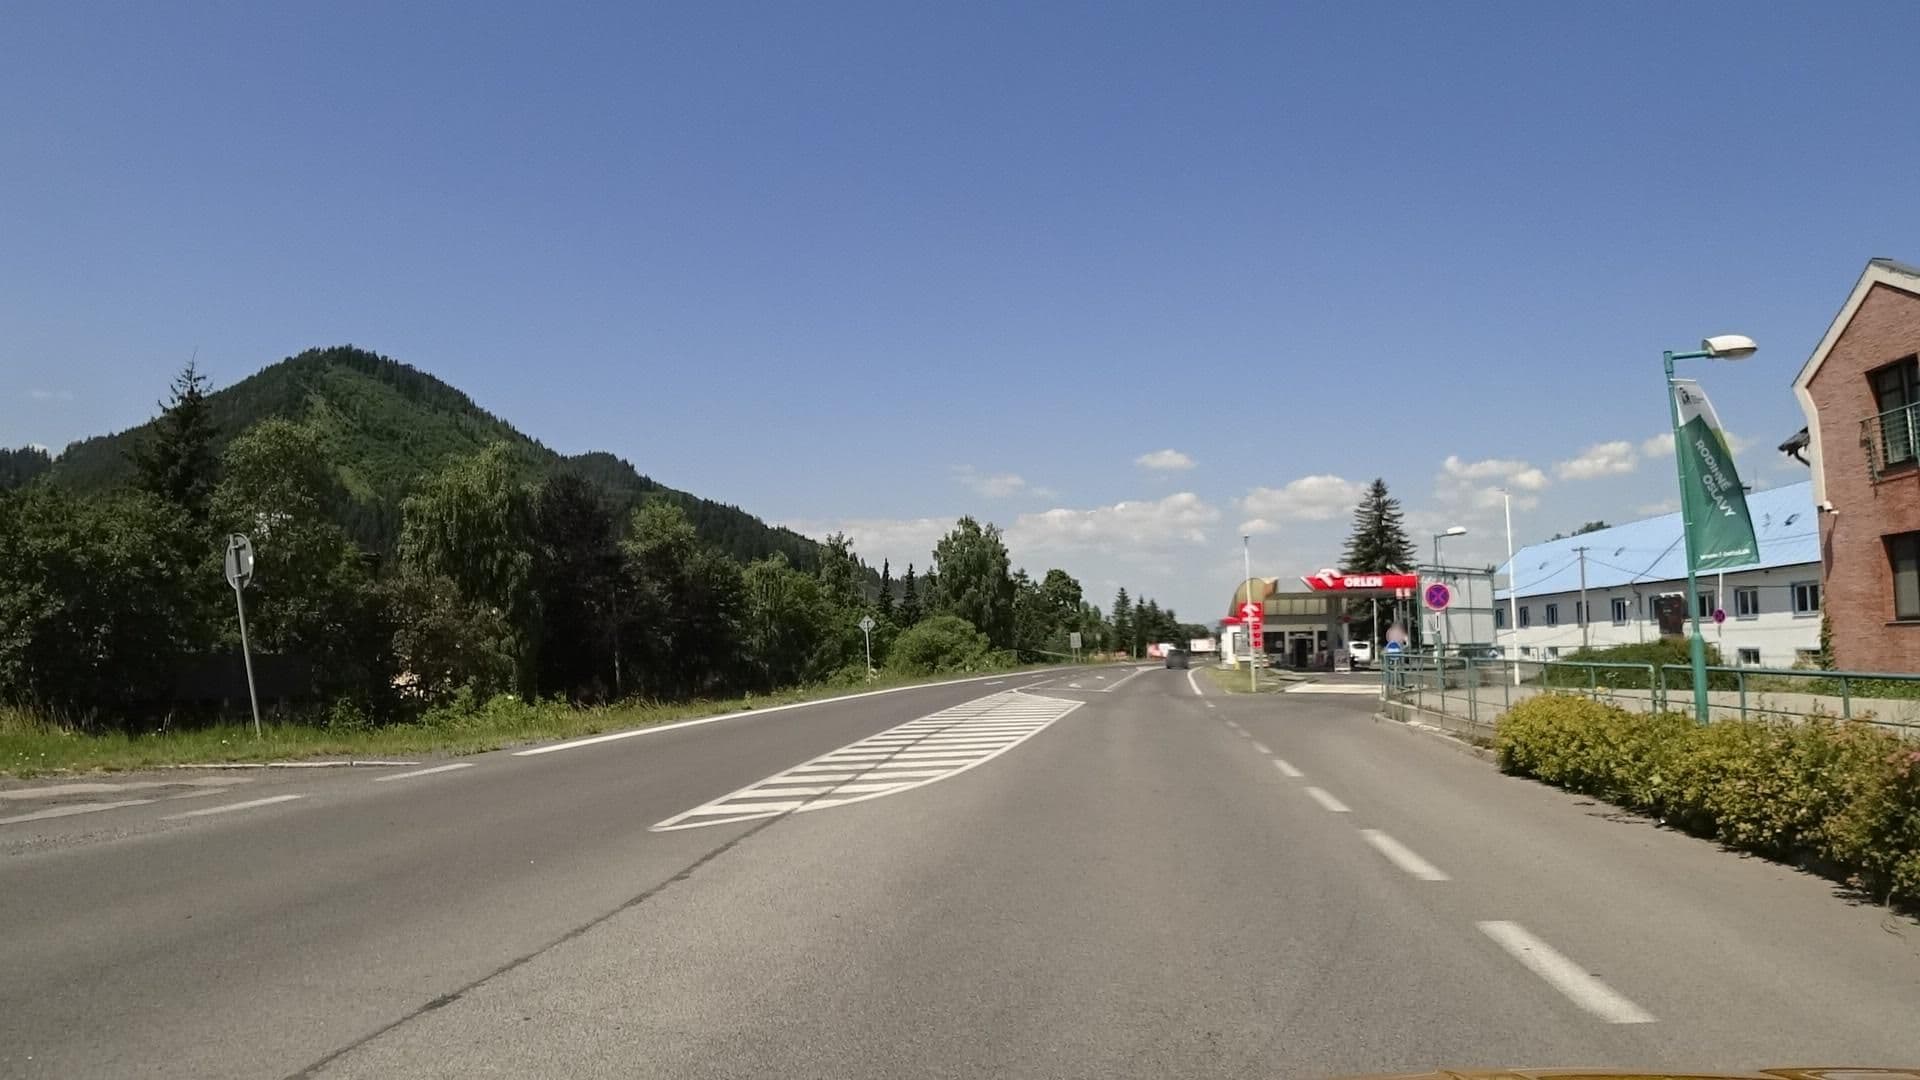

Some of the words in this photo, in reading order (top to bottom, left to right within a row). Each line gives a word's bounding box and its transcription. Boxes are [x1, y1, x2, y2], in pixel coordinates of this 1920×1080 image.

[1696, 440, 1731, 491] RODINNÉ
[1703, 475, 1736, 516] OSLAVY
[1344, 577, 1382, 588] ORLEN
